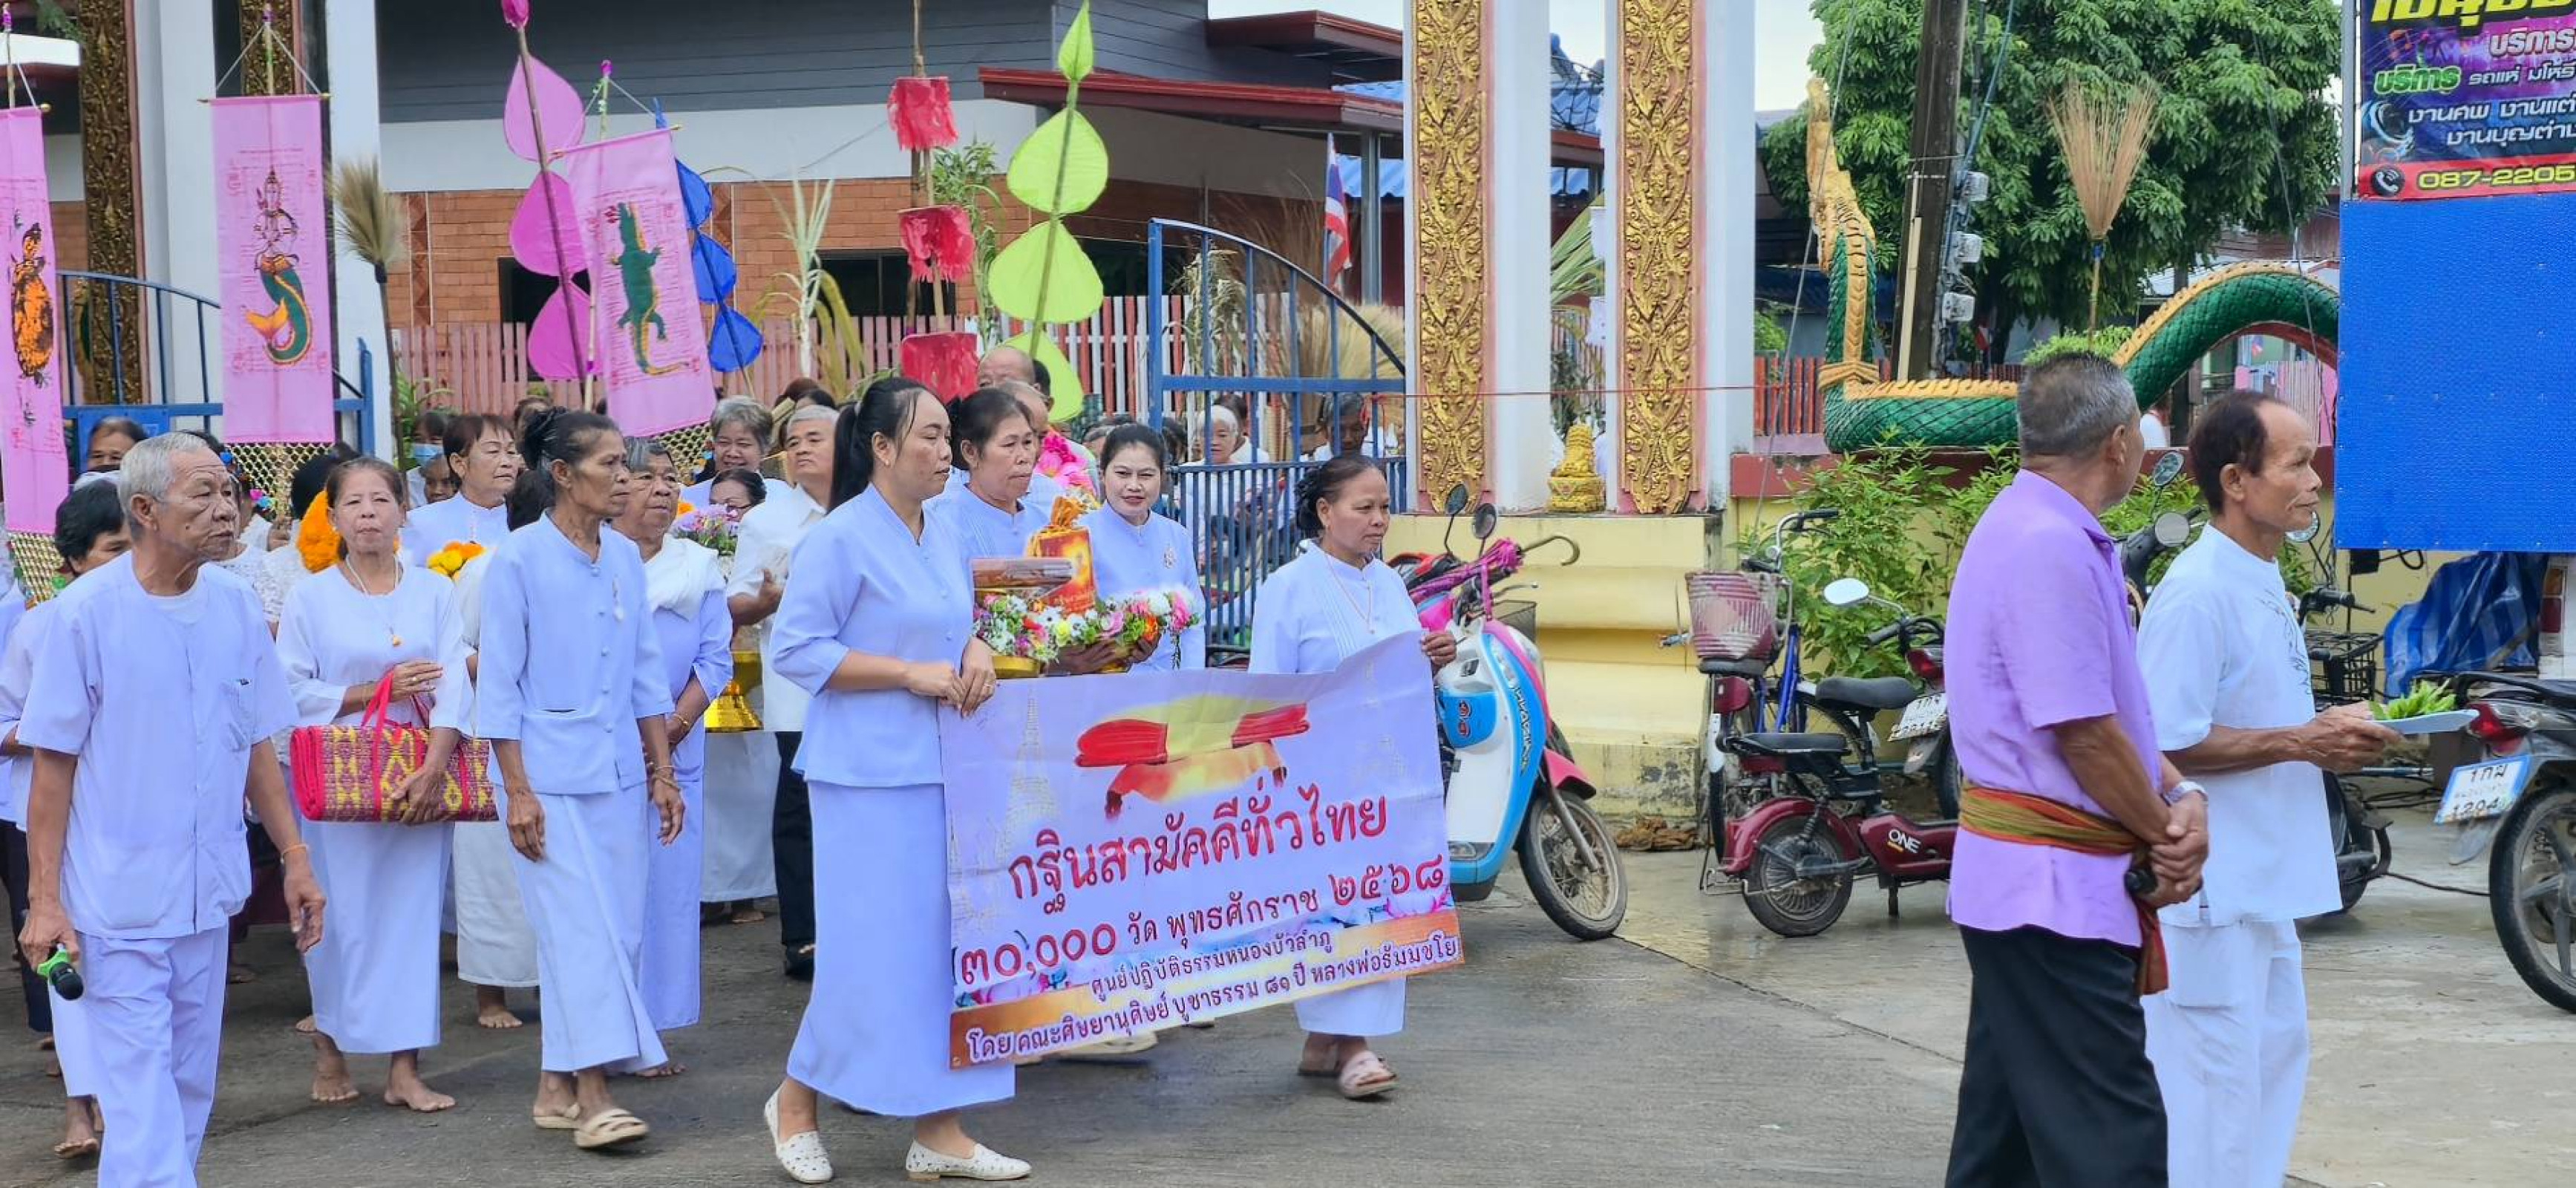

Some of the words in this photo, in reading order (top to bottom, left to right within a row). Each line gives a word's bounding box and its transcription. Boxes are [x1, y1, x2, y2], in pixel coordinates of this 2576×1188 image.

[2489, 27, 2576, 57] บริการ
[2374, 64, 2462, 95] บริการ
[2468, 66, 2520, 85] รถแห่
[1008, 778, 1387, 915] กฐินสามัคคีทั่วไทย
[1888, 829, 1921, 854] ONE
[1128, 912, 1158, 945] วัด
[1167, 888, 1319, 949] พุทธศักราช
[1328, 855, 1444, 907] ๒๕๖๘
[969, 1028, 1010, 1060] โดย
[1292, 962, 1307, 988] ปี
